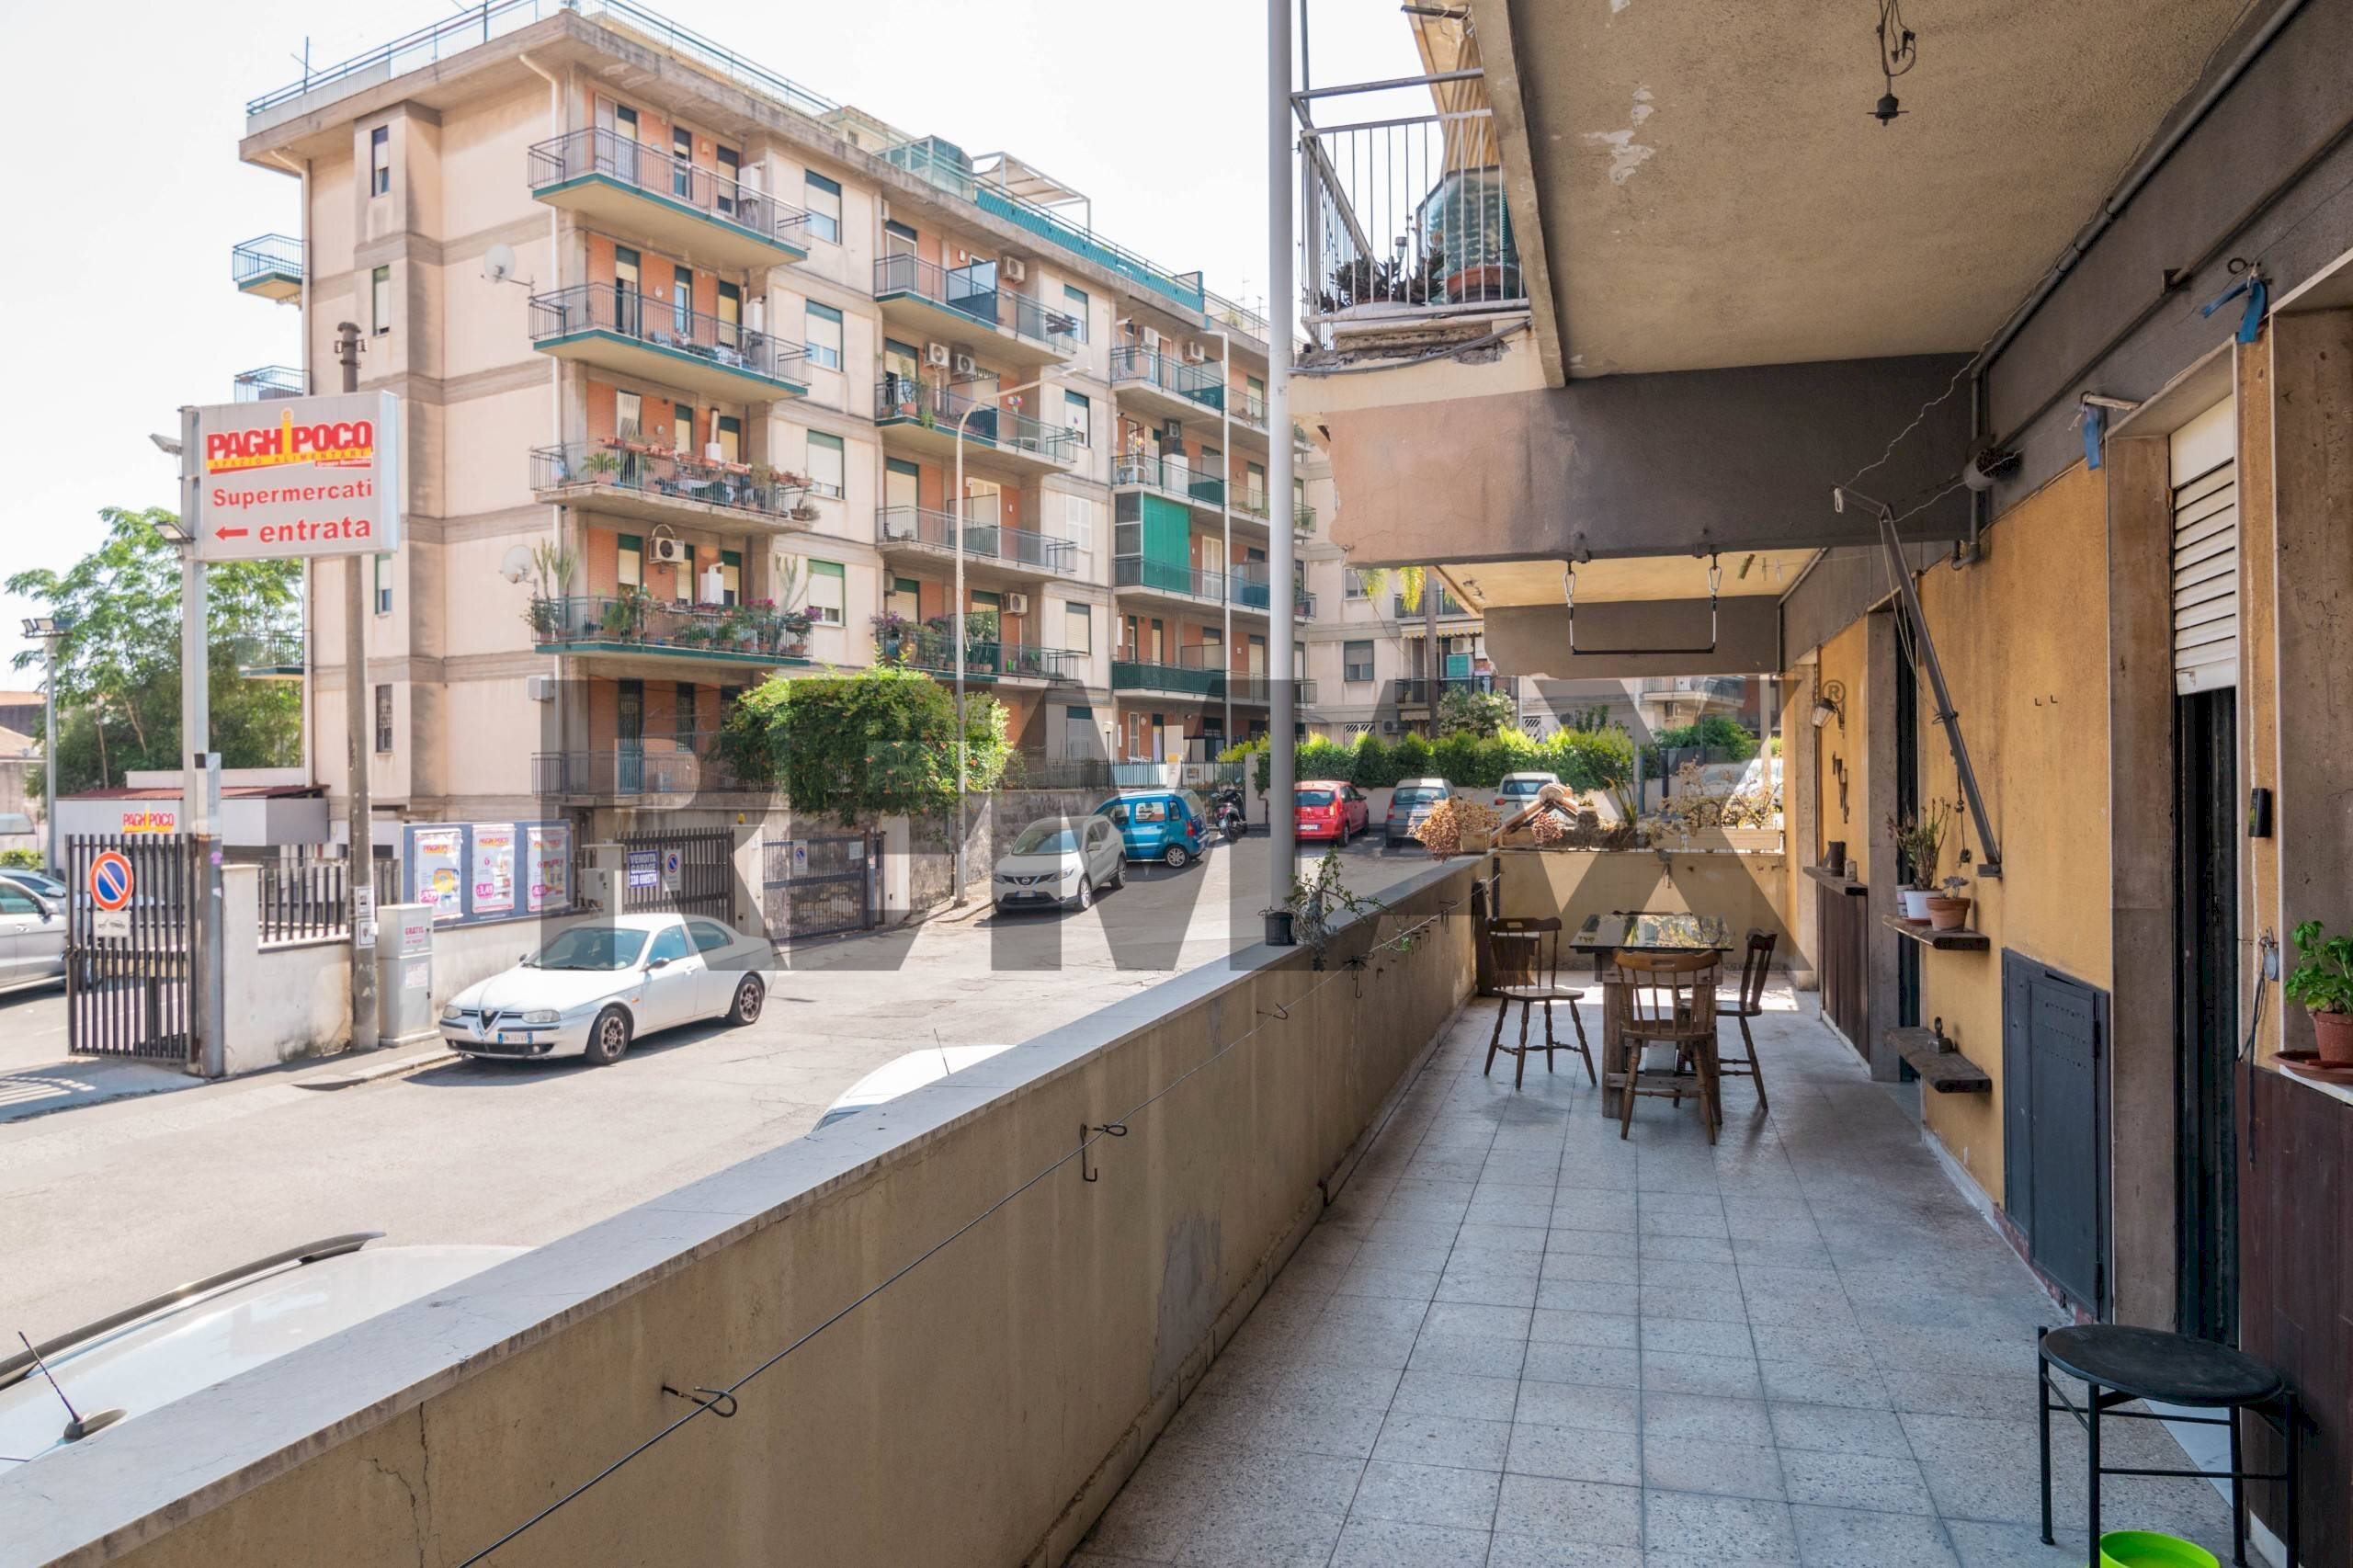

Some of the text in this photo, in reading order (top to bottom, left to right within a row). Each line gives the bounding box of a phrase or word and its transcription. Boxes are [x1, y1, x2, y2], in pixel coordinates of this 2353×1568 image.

[212, 479, 372, 509] Supermercati
[259, 517, 370, 543] entrata
[630, 854, 656, 864] VENDITA
[631, 863, 656, 873] GARAGE
